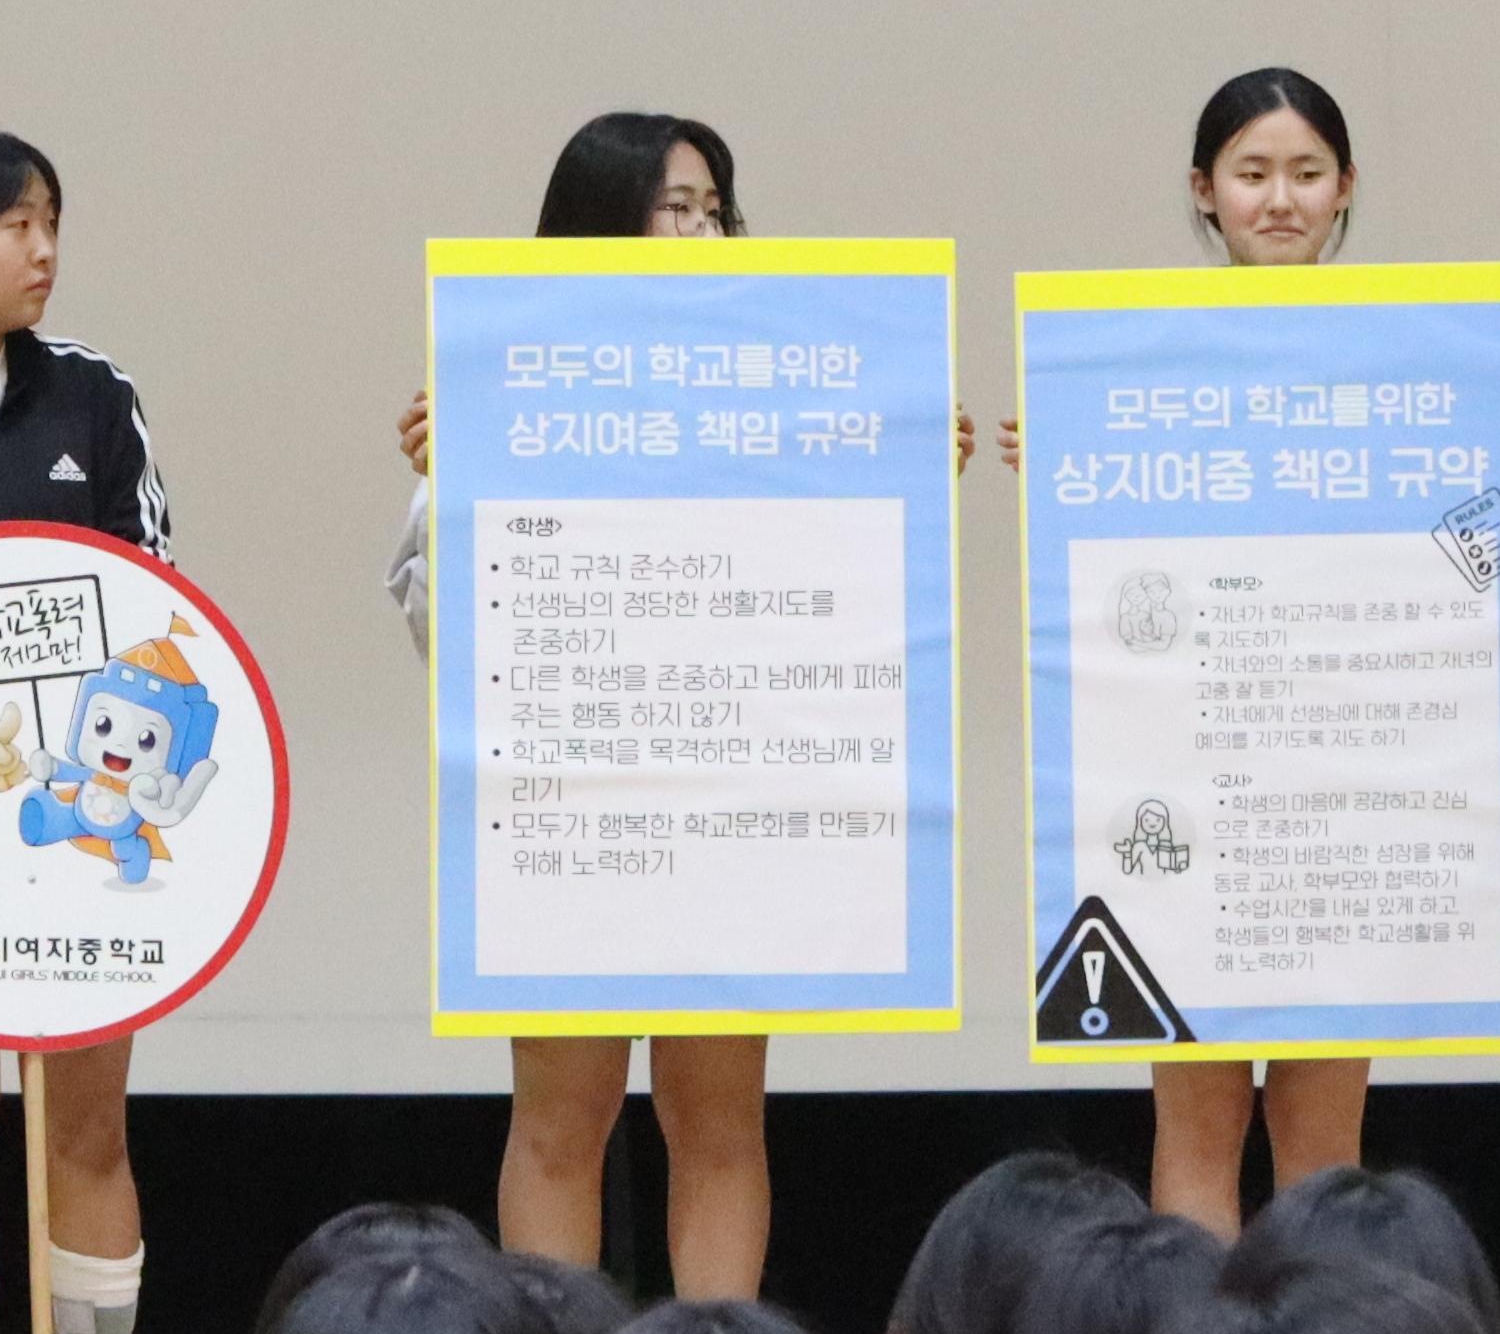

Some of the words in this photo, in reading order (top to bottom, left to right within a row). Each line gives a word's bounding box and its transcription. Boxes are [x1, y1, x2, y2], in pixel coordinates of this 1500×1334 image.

[505, 344, 632, 388] 모두의
[1105, 386, 1231, 430] 모두의
[507, 411, 680, 457] 상지여중
[697, 410, 778, 455] 책임
[796, 411, 882, 456] 규약
[1052, 449, 1254, 505] 상지여중
[1273, 448, 1370, 499] 책임
[1388, 446, 1489, 498] 규약
[1455, 498, 1494, 524] RULES
[507, 517, 562, 537] <학생>
[511, 555, 560, 580] 학교
[570, 555, 619, 580] 규칙
[629, 555, 732, 580] 준수하기
[511, 591, 612, 617] 선생님의
[624, 591, 699, 617] 정당한
[708, 590, 834, 617] 생활지도를
[1211, 605, 1264, 624] 자녀가
[1271, 604, 1357, 623] 학교규칙을
[1364, 603, 1398, 621] 존중
[1404, 602, 1420, 620] 할
[1427, 602, 1444, 620] 수
[1450, 601, 1484, 620] 있도
[513, 629, 615, 655] 존중하기
[1194, 631, 1211, 648] 록
[1217, 630, 1287, 648] 지도하기
[1212, 655, 1282, 673] 자녀와의
[1289, 654, 1340, 672] 소통을
[1440, 650, 1492, 669] 자녀의
[512, 665, 561, 691] 다른
[572, 665, 646, 691] 학생을
[657, 665, 758, 691] 존중하고
[769, 664, 843, 690] 남에게
[853, 664, 901, 690] 피해
[1236, 681, 1252, 699] 잘
[1259, 680, 1293, 698] 듣기
[511, 703, 561, 729] 주는
[573, 703, 620, 729] 행동
[630, 702, 680, 728] 하지
[691, 702, 740, 728] 않기
[1212, 705, 1283, 724] 자녀에게
[1290, 704, 1359, 722] 선생님에
[1365, 703, 1400, 721] 대해
[1406, 702, 1458, 721] 존경심
[512, 739, 639, 764] 학교폭력을
[650, 738, 750, 764] 목격하면
[762, 738, 860, 763] 선생님께
[872, 738, 894, 763] 알
[1195, 731, 1247, 750] 예의를
[1254, 730, 1324, 748] 지키도록
[1330, 729, 1363, 747] 지도
[1370, 728, 1405, 746] 하기
[512, 777, 562, 803] 리기
[1232, 795, 1286, 813] 학생의
[1292, 793, 1347, 812] 마음에
[1354, 791, 1425, 811] 공감하고
[1432, 791, 1468, 810] 진심
[512, 813, 588, 839] 모두가
[598, 813, 674, 839] 행복한
[684, 812, 810, 838] 학교문화를
[820, 812, 894, 837] 만들기
[1213, 821, 1249, 839] 으로
[1256, 819, 1328, 839] 존중하기
[513, 850, 561, 876] 위해
[573, 850, 673, 876] 노력하기
[1233, 846, 1288, 865] 학생의
[1295, 845, 1369, 865] 바람직한
[1376, 843, 1431, 863] 성장을
[1437, 842, 1474, 861] 위해
[1214, 873, 1250, 893] 동료
[1304, 870, 1378, 890] 학부모와
[1385, 870, 1458, 890] 협력하기
[1234, 898, 1326, 918] 수업시간을
[1334, 898, 1369, 917] 내실
[1377, 897, 1413, 916] 있게
[1215, 926, 1288, 946] 학생들의
[1296, 925, 1349, 945] 행복한
[1358, 923, 1450, 943] 학교생활을
[1458, 922, 1475, 941] 위
[1216, 953, 1233, 972] 해
[1240, 952, 1314, 972] 노력하기
[53, 970, 99, 982] MIDDLE
[104, 971, 156, 983] SCHOOL
